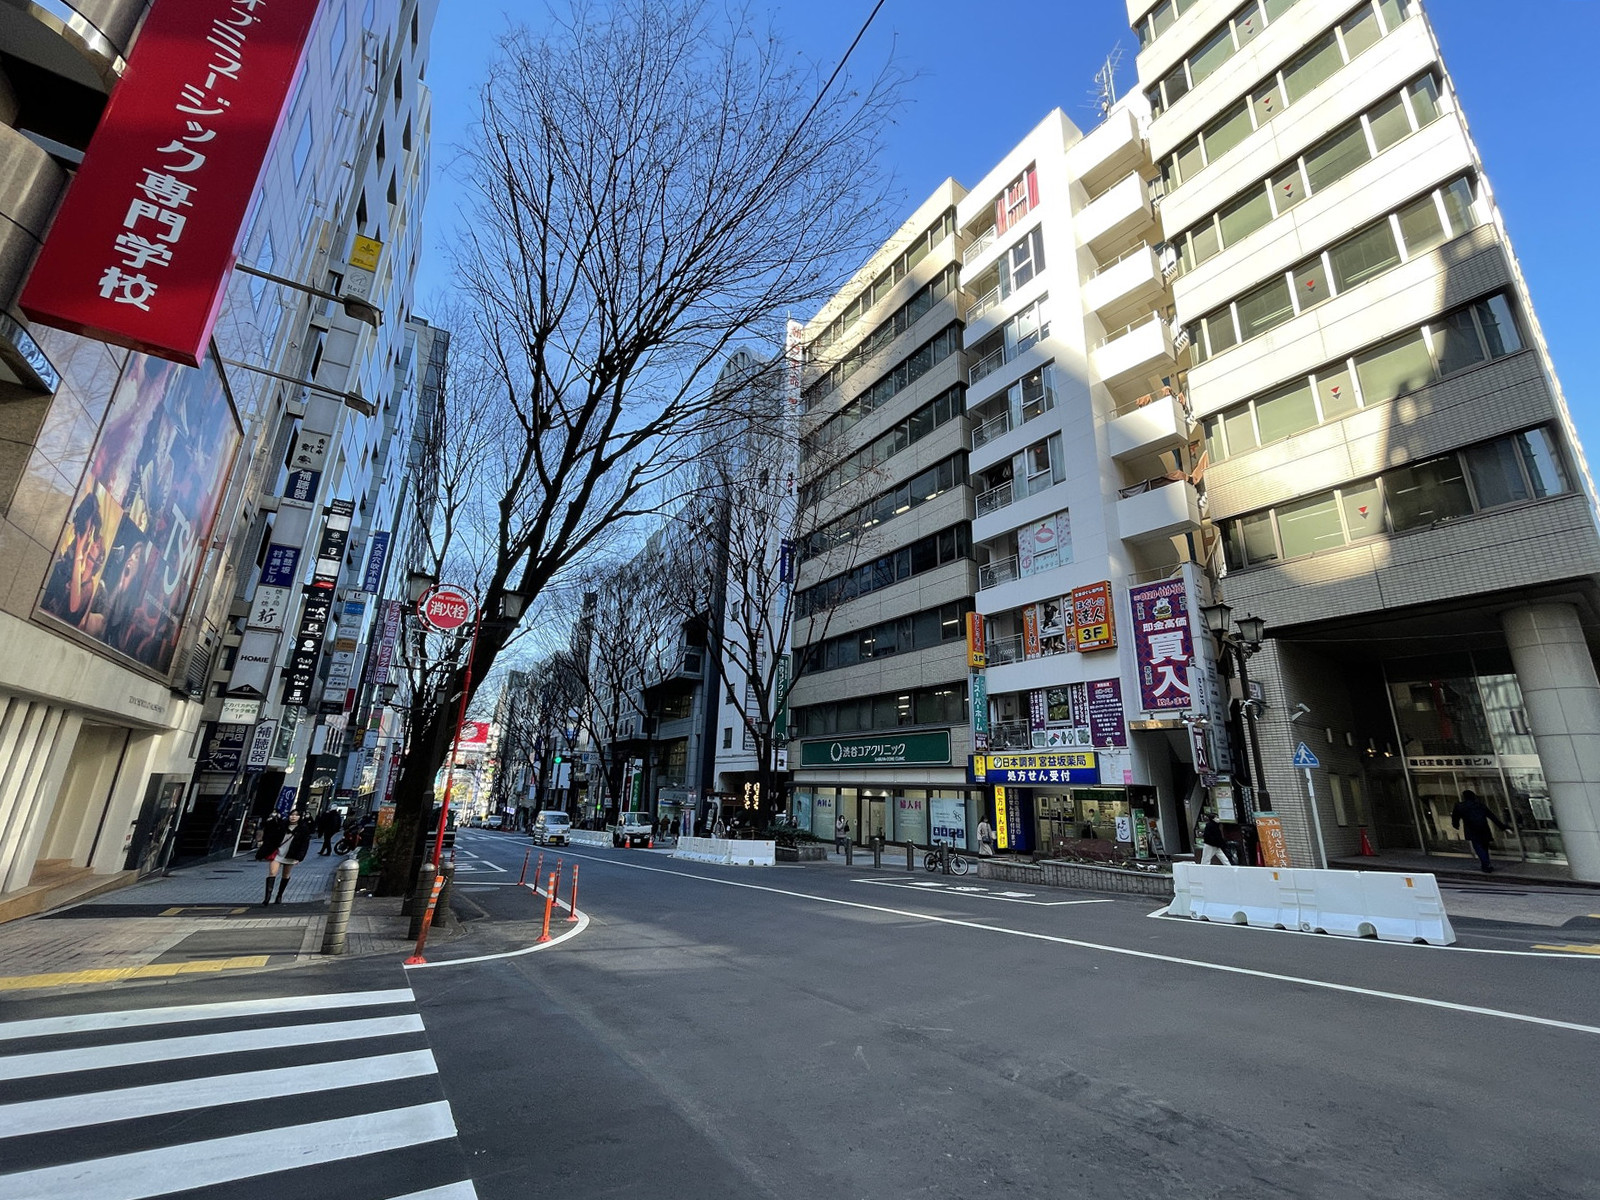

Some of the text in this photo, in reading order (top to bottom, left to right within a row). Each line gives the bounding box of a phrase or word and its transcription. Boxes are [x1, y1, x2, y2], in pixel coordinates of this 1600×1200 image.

[281, 550, 296, 574] 宮益坂
[258, 608, 277, 624] 新
[430, 601, 466, 619] 消火栓
[1077, 608, 1106, 626] 達人
[1143, 617, 1187, 632] 即金高価
[1083, 627, 1102, 640] 3F
[240, 654, 270, 664] HOMIE
[974, 654, 984, 662] 3F
[215, 733, 245, 741] 専門店
[252, 726, 272, 762] 補聴器
[842, 743, 906, 757] 渋谷コアクリニック
[1003, 755, 1086, 767] 日本調剤 宮益坂薬局
[1007, 770, 1070, 781] 処方せん受付
[900, 800, 921, 810] 婦人科
[996, 787, 1006, 845] 処方せん受付
